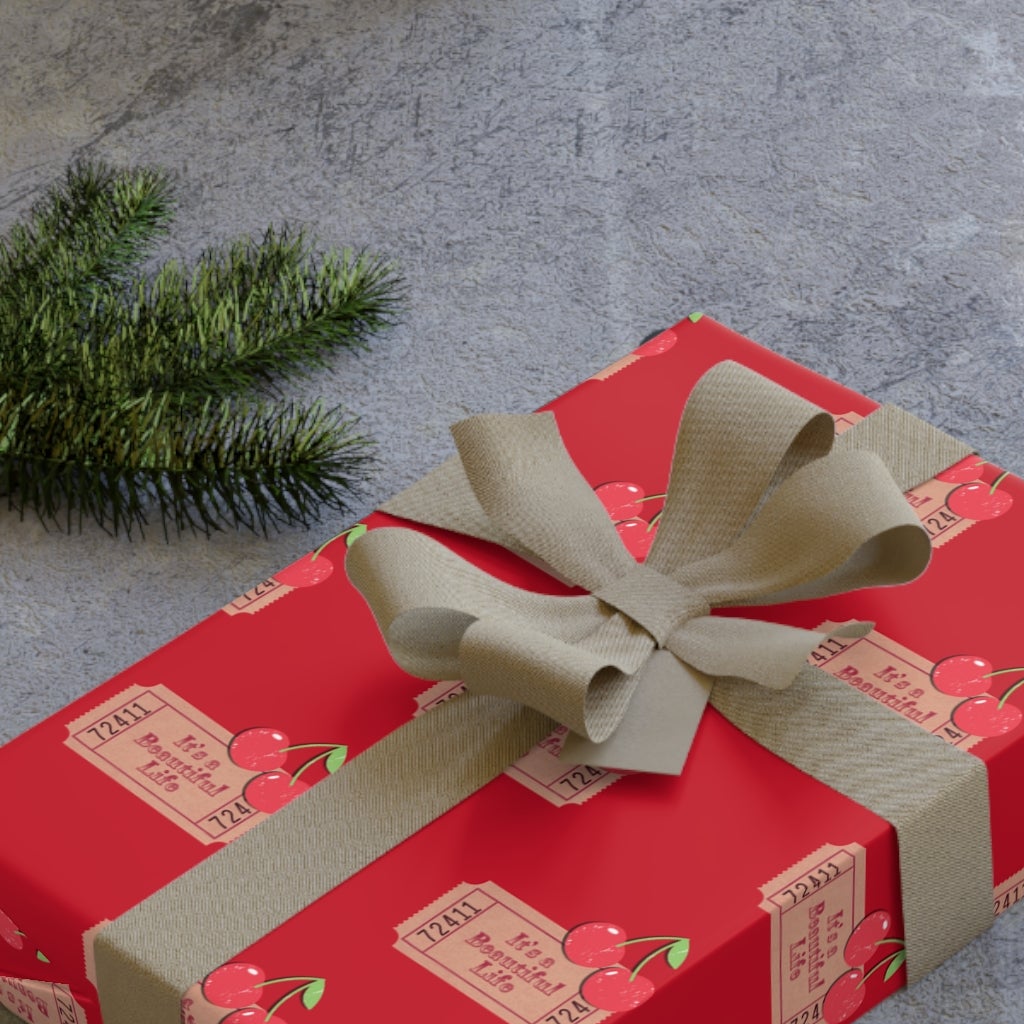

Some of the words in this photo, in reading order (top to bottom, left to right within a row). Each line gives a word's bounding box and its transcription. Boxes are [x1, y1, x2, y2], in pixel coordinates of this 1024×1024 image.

[833, 665, 937, 724] Beautiful
[873, 665, 911, 690] It's
[909, 688, 925, 699] a
[87, 702, 151, 741] 72411
[133, 732, 230, 797] Beautiful
[173, 734, 209, 761] It's
[204, 758, 221, 770] a
[136, 759, 180, 793] Life
[560, 764, 602, 791] 724
[208, 801, 251, 829] 724
[782, 862, 841, 904] 72411
[416, 901, 482, 943] 72411
[827, 908, 844, 943] It's
[464, 931, 567, 996] Beautiful
[505, 932, 542, 959] It's
[538, 957, 556, 969] a
[789, 936, 806, 981] Life
[808, 900, 825, 993] Beautiful
[469, 960, 515, 993] Life
